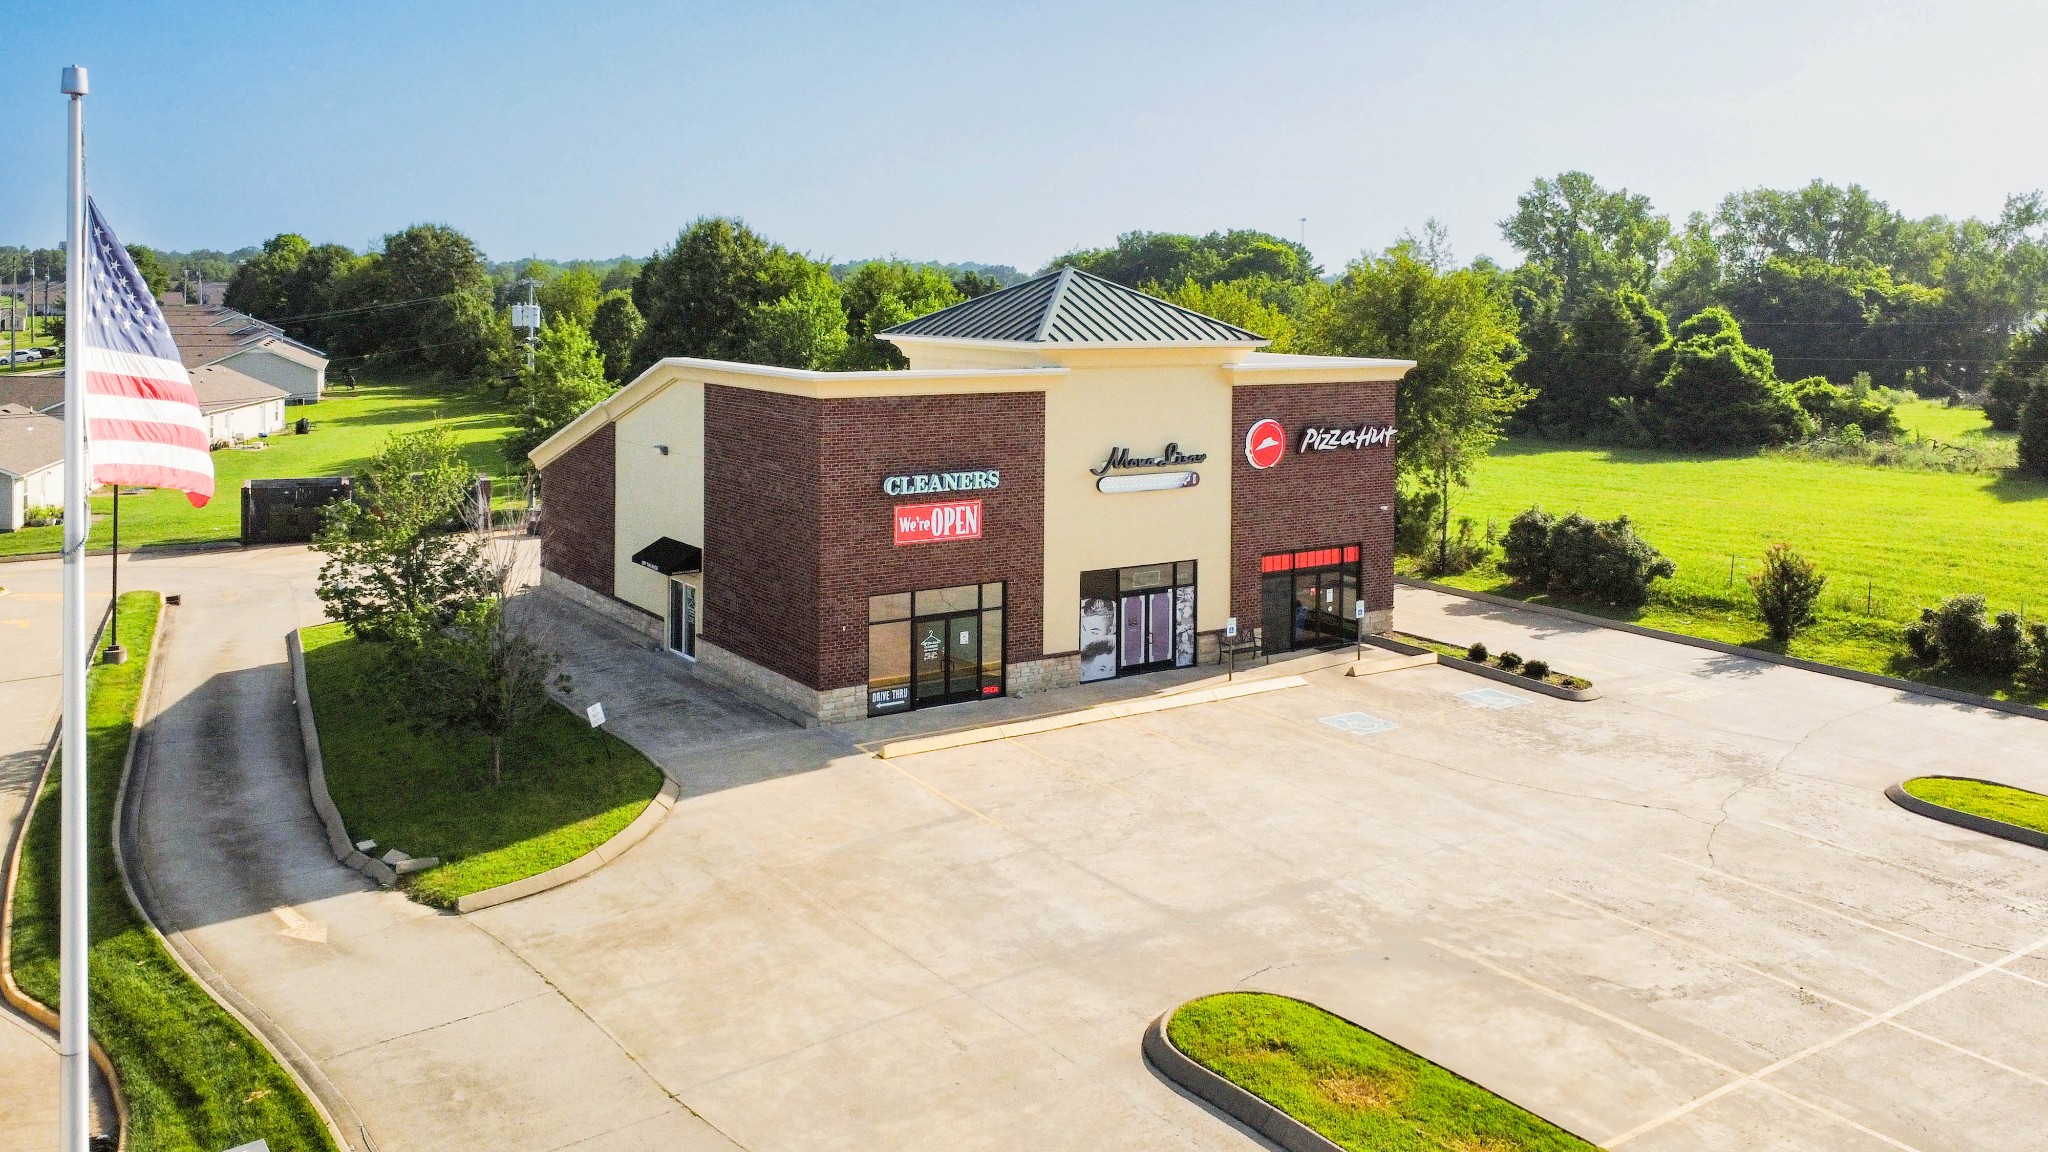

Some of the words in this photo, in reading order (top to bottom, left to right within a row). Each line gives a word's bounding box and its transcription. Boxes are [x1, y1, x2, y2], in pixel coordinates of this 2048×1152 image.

[1089, 446, 1156, 476] Mona
[1155, 442, 1207, 467] Lisa
[883, 470, 999, 495] CLEANERS
[899, 516, 931, 533] We're
[931, 505, 978, 537] OPEN
[872, 690, 890, 703] DRIVE
[891, 687, 908, 700] THRU
